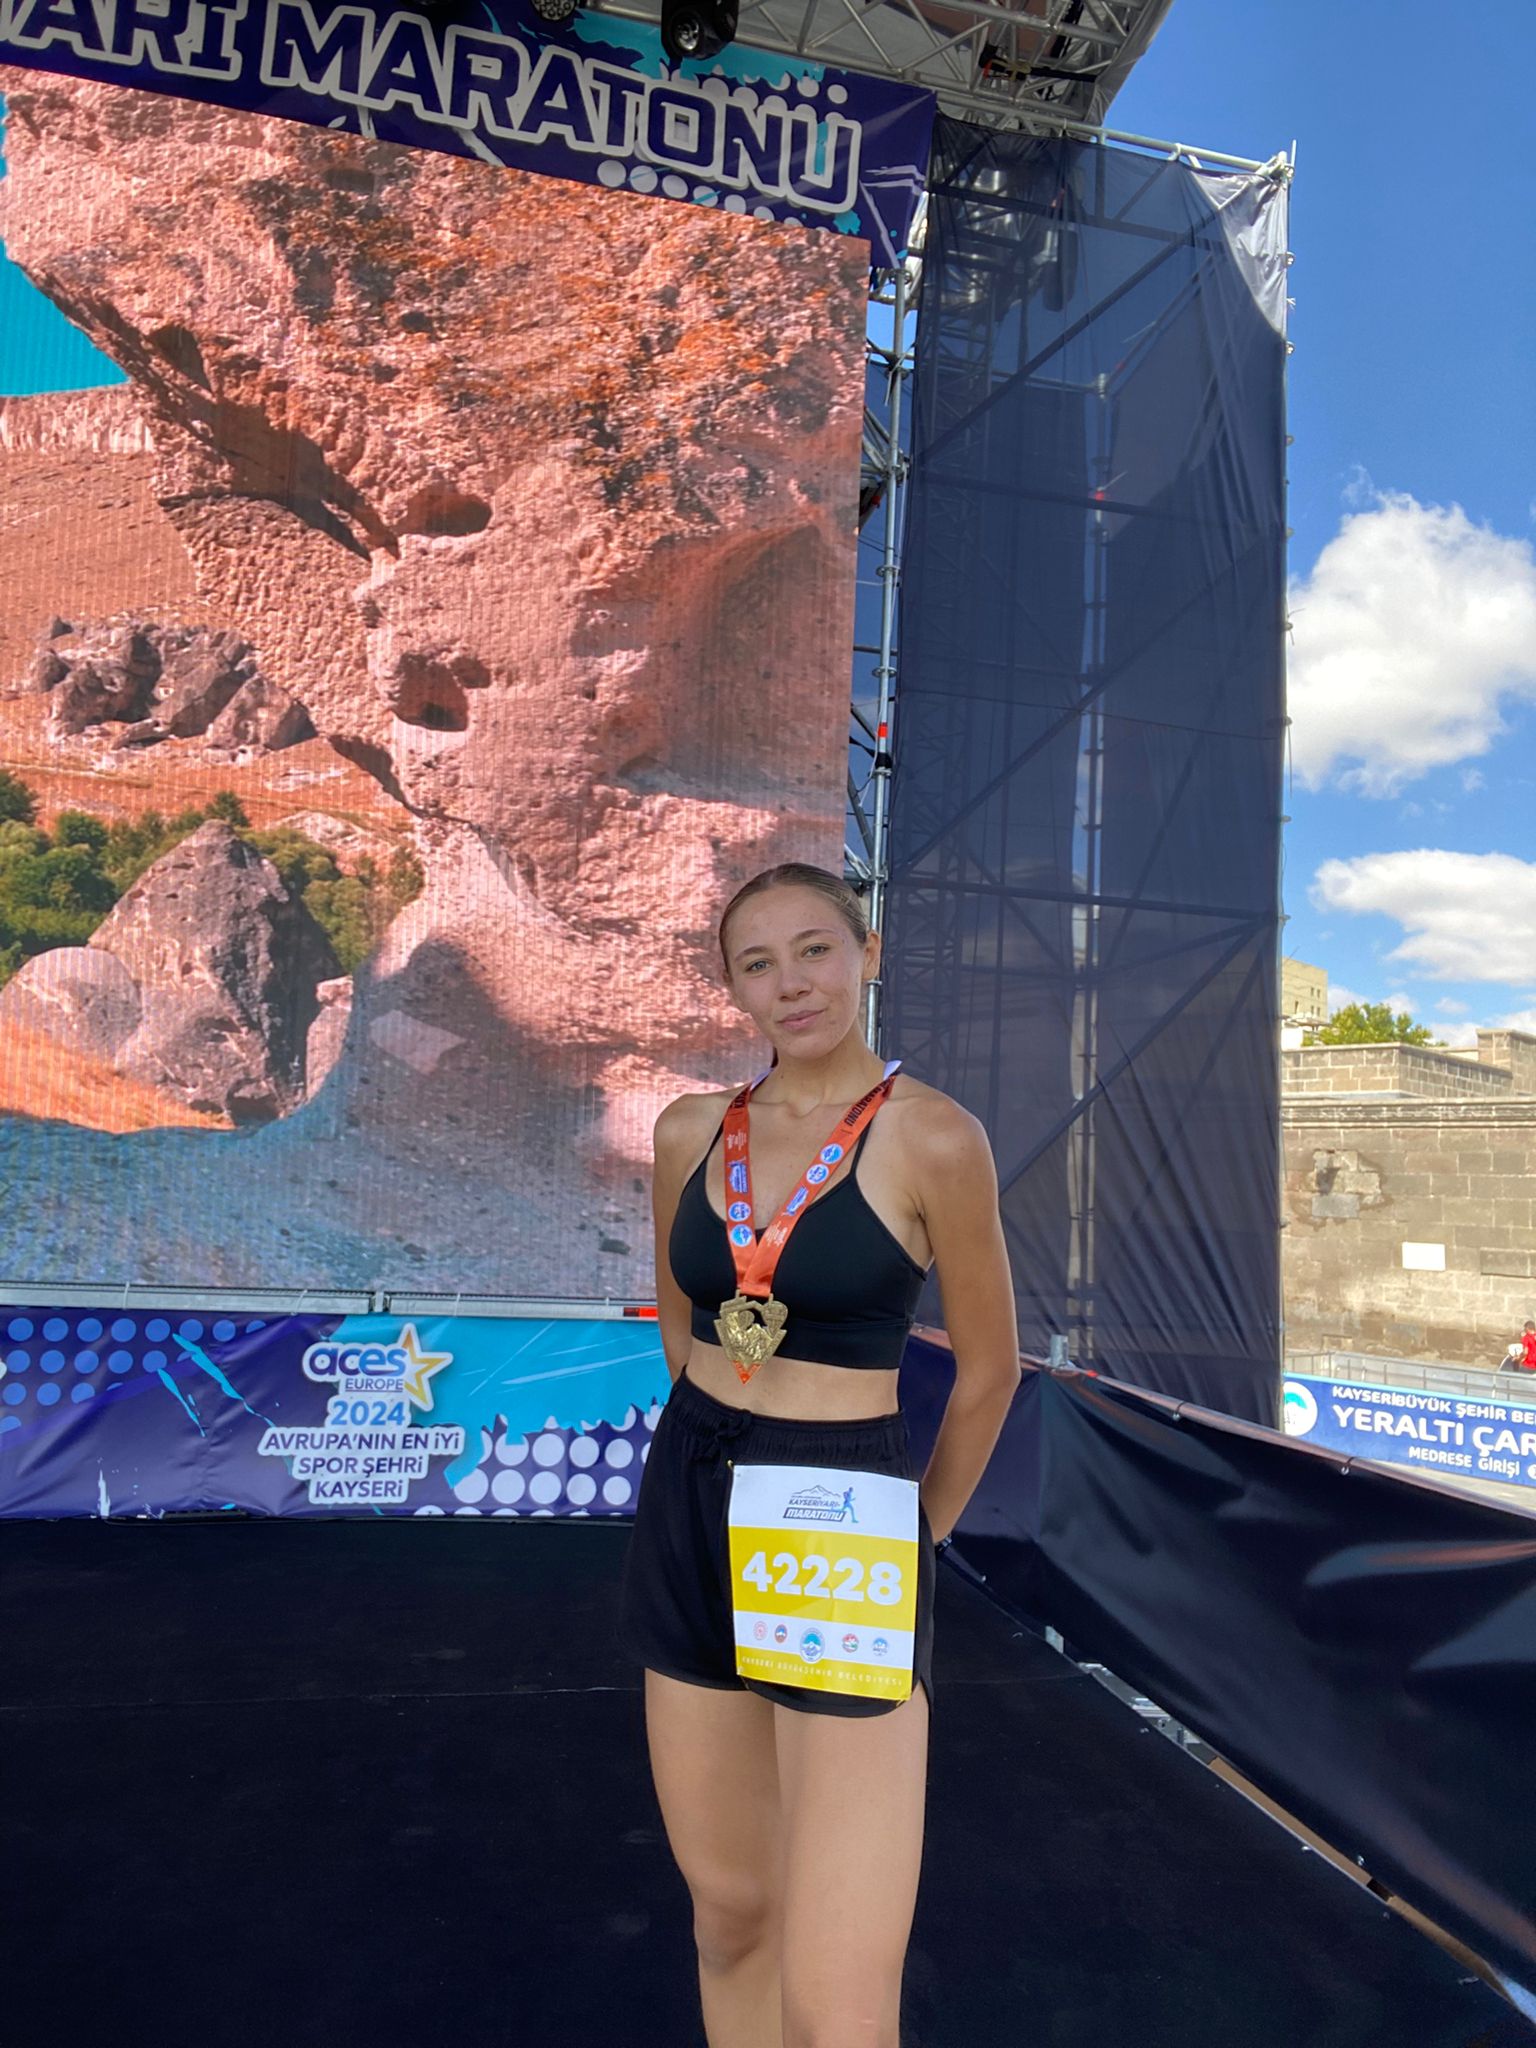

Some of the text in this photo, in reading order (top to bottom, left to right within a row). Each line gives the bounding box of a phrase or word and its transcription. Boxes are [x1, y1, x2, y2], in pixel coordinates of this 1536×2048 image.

[0, 0, 862, 214] ARI MARATONU
[308, 1346, 409, 1377] aces
[344, 1377, 404, 1392] EUROPE
[330, 1400, 406, 1426] 2024
[1455, 1402, 1507, 1421] ŞEHİR
[1511, 1409, 1536, 1426] BE
[264, 1432, 396, 1450] AVRUPA'NIN
[401, 1432, 429, 1449] EN
[1332, 1404, 1536, 1457] YERALTI ÇAR
[298, 1455, 423, 1478] SPOR ŞEHRİ
[1408, 1446, 1473, 1468] MEDRESE
[1478, 1456, 1520, 1479] GİRİŞİ
[314, 1479, 403, 1498] KAYSERİ
[786, 1508, 844, 1521] MARATONU
[742, 1551, 903, 1607] 42228
